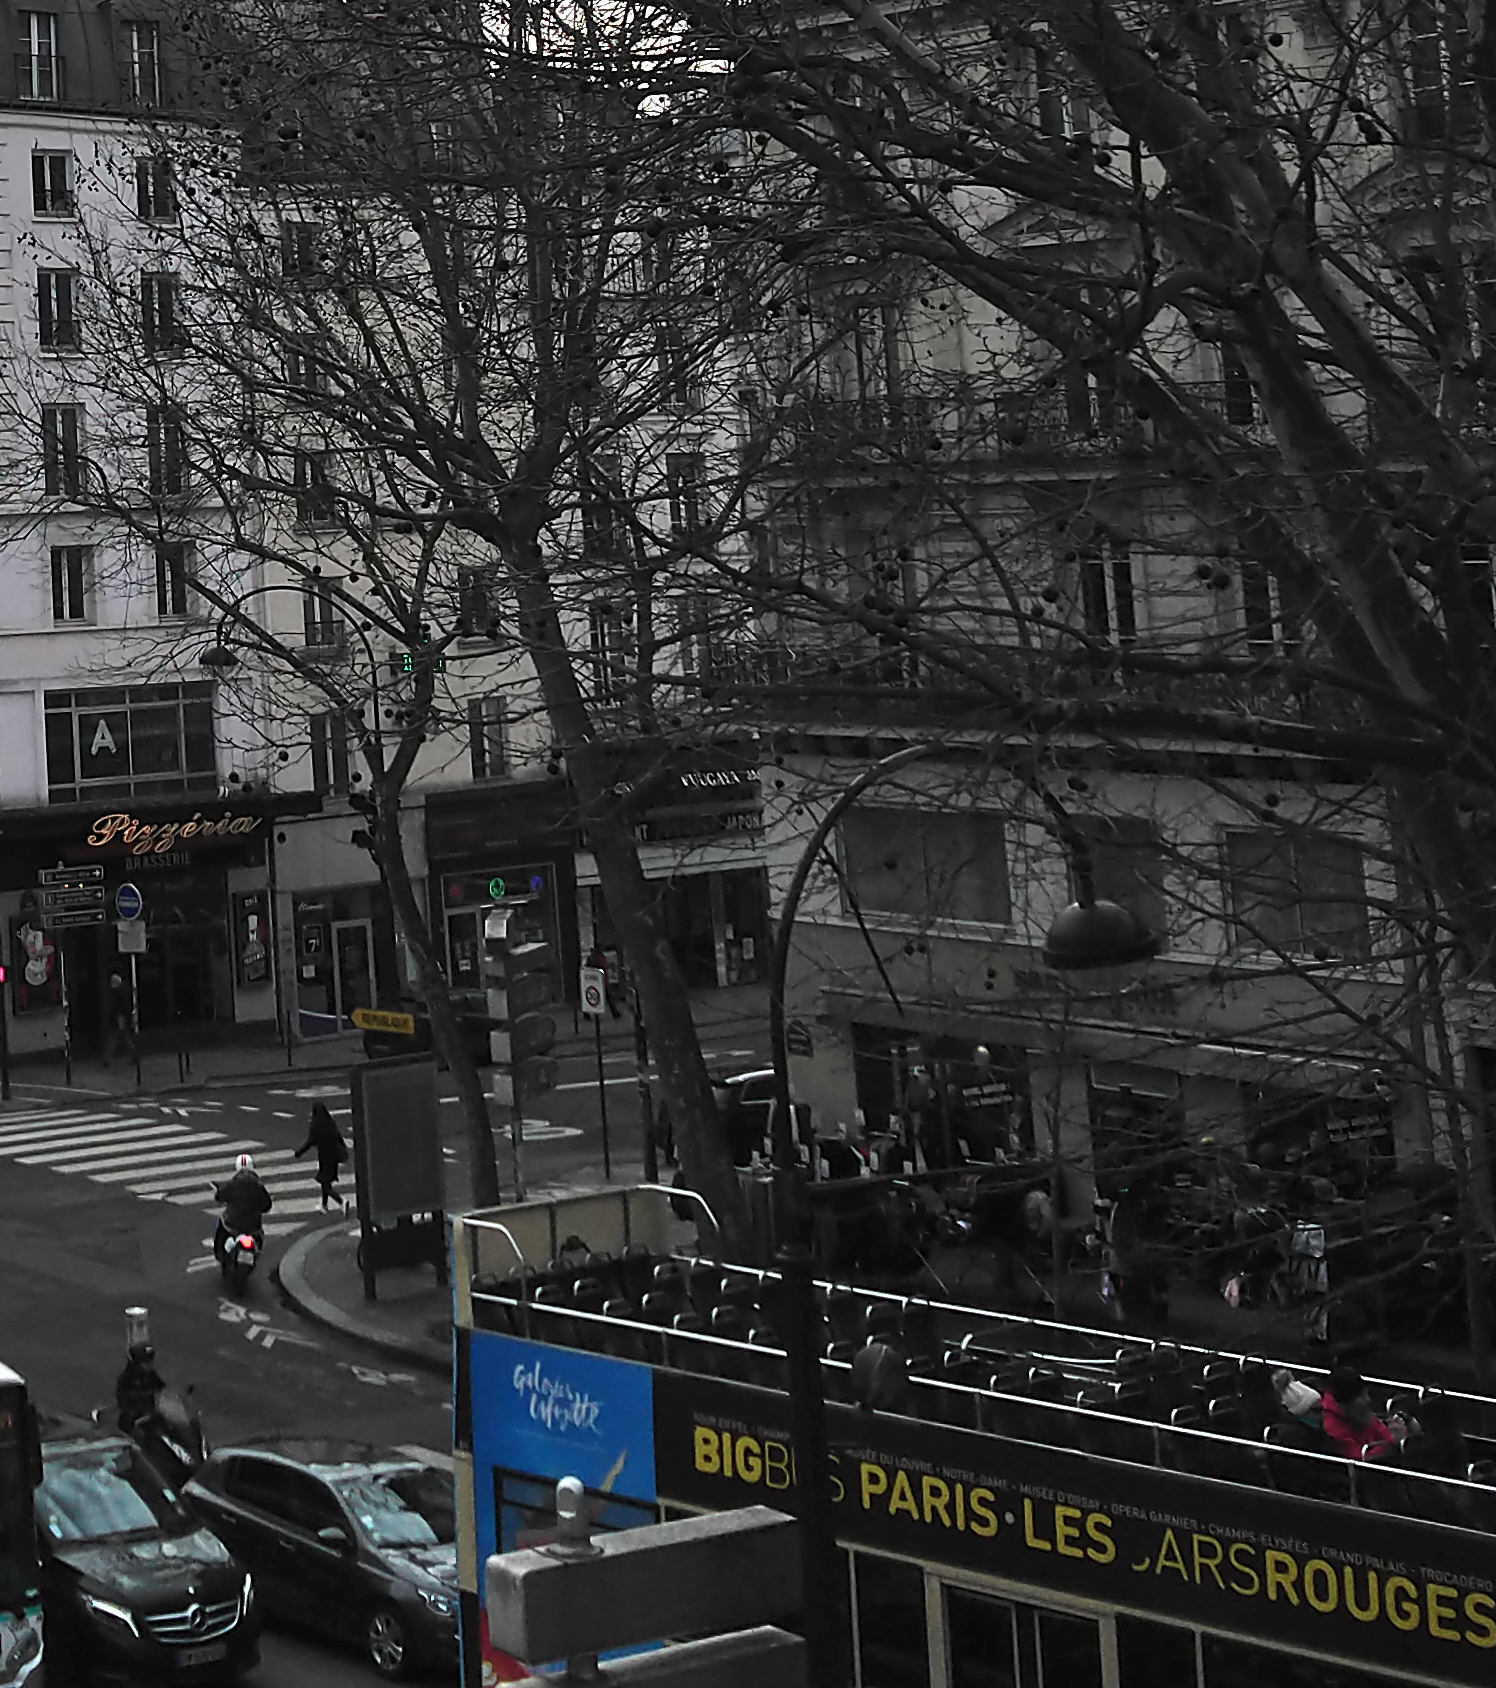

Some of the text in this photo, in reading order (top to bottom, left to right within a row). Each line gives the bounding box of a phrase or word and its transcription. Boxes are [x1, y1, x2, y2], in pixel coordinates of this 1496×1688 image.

[90, 718, 117, 757] A
[85, 811, 264, 855] Pizzéria
[124, 851, 191, 871] BRASSERIE
[859, 1461, 1000, 1538] PARIS
[1022, 1496, 1118, 1565] LES
